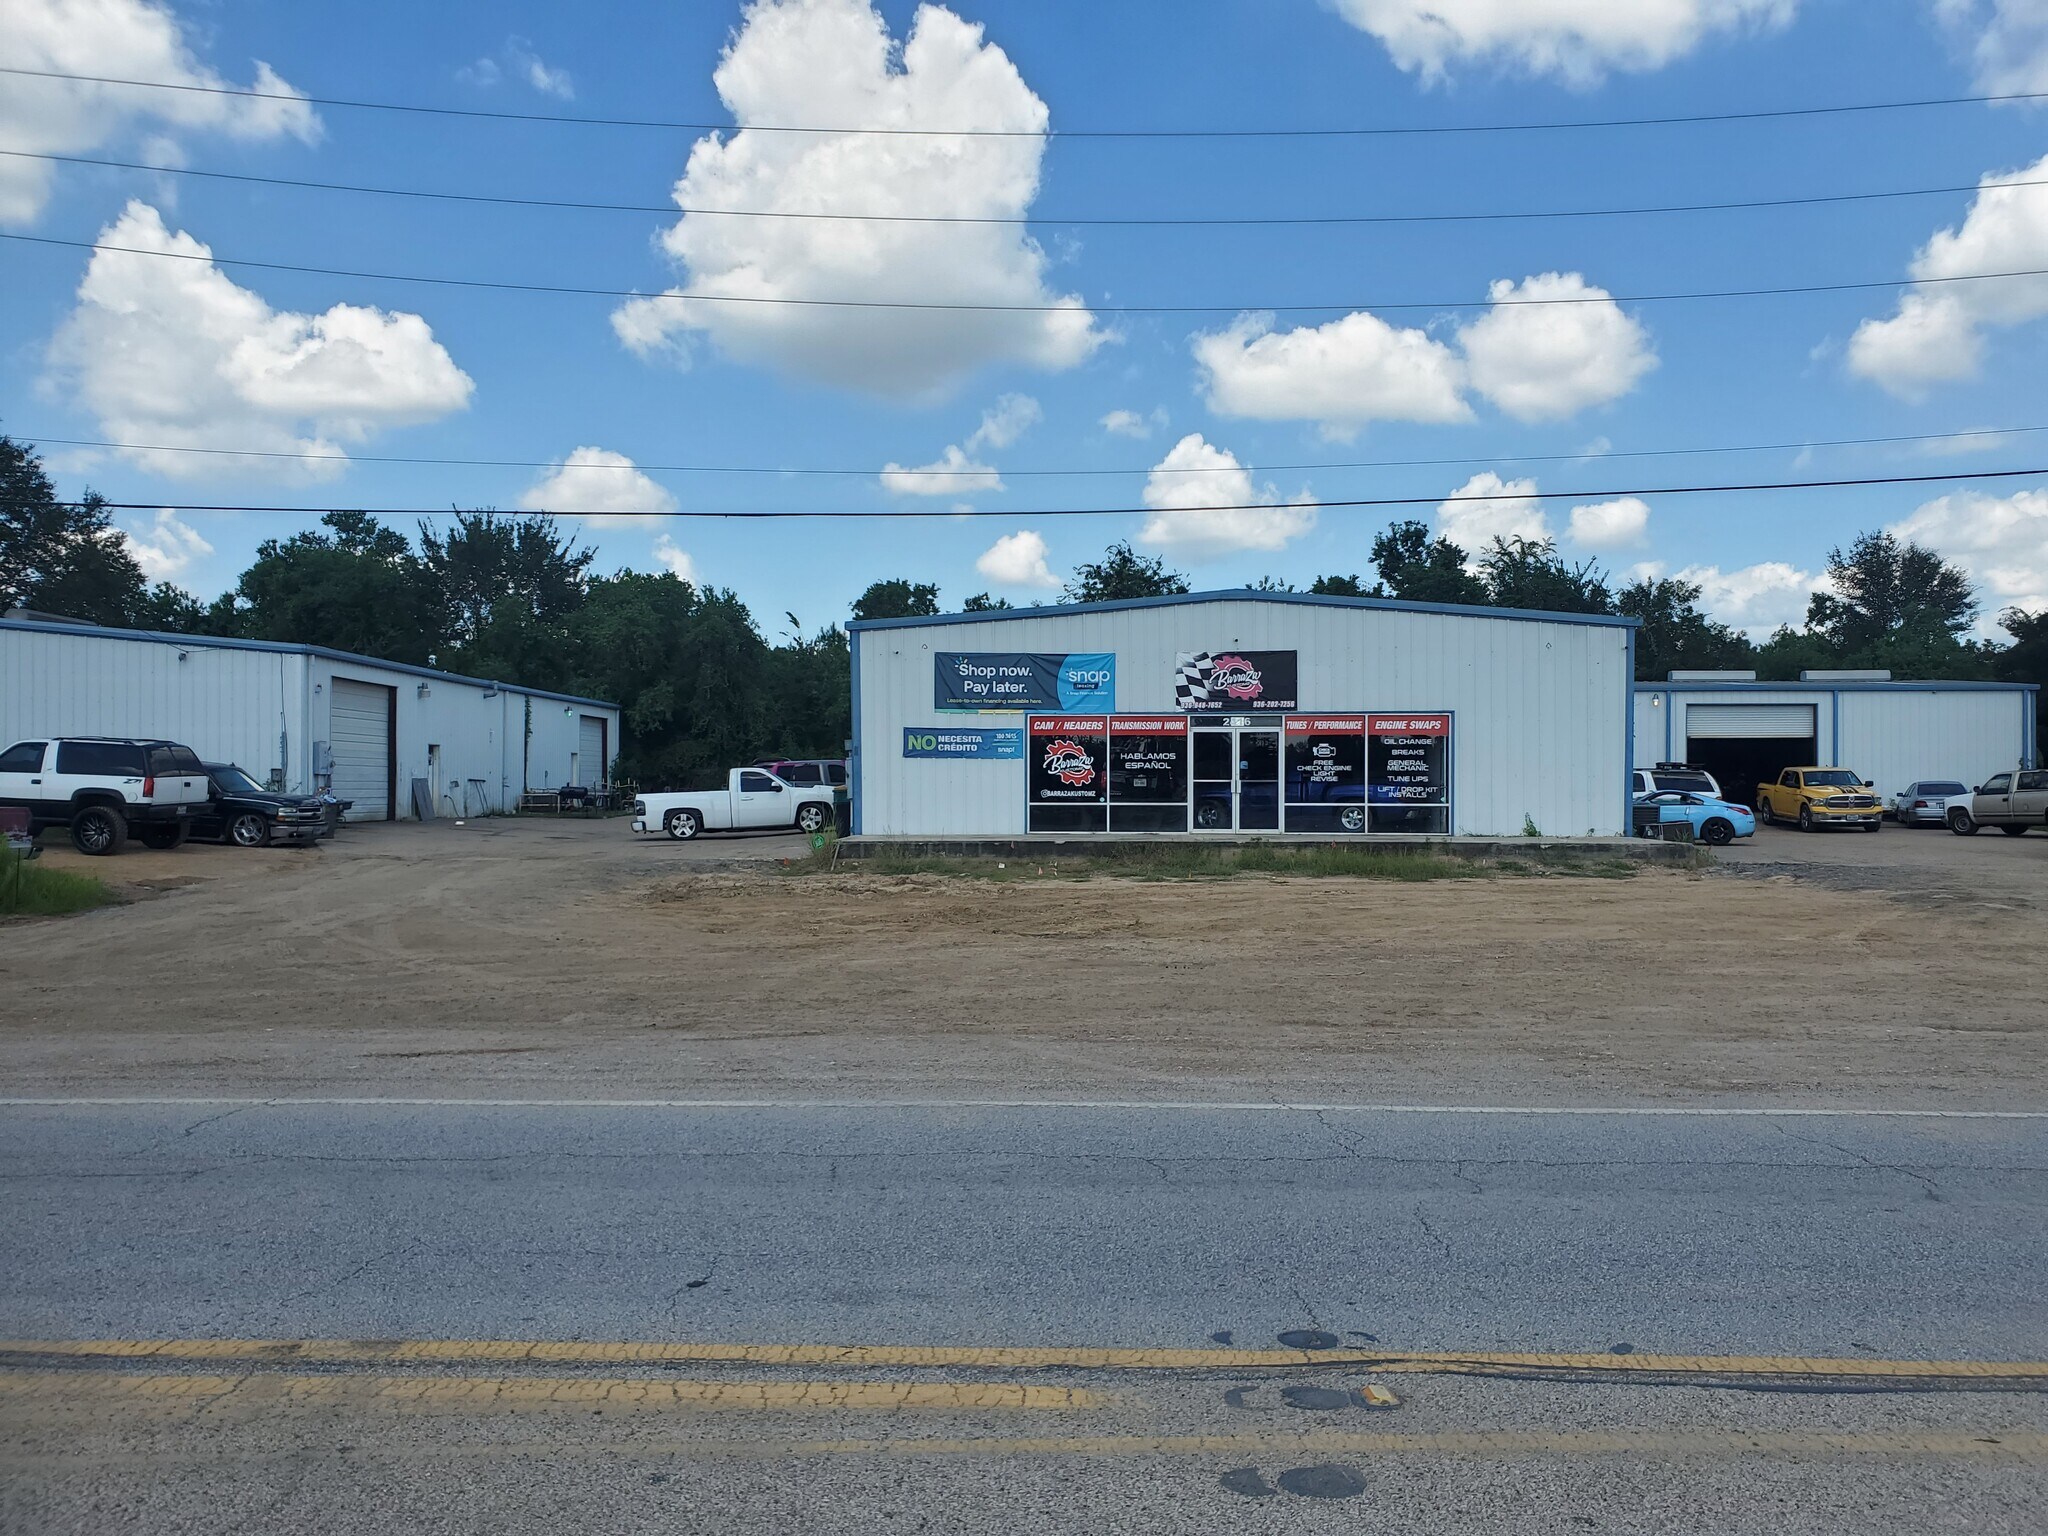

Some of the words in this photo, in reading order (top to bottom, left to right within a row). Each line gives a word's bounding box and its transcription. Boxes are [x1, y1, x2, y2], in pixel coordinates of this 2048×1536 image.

[959, 663, 996, 679] Shop
[999, 667, 1033, 677] now.
[1068, 670, 1110, 686] snap
[964, 681, 989, 696] Pay
[993, 681, 1028, 693] later.
[1034, 721, 1054, 730] CAM
[1056, 721, 1061, 730] /
[1063, 721, 1104, 730] HEADERS
[1111, 721, 1162, 730] TRANSMISSION
[1164, 721, 1185, 730] WORK
[1286, 721, 1307, 730] TUNES
[1308, 721, 1312, 730] /
[1313, 721, 1363, 730] PERFORMANCE
[1375, 721, 1407, 730] ENGINE
[1409, 721, 1441, 730] SWAPS
[908, 734, 937, 751] NO
[938, 735, 983, 743] NECESITA
[938, 743, 978, 752] CRÉDITO
[1120, 752, 1176, 760] HABLAMOS
[1125, 760, 1172, 769] ESPAÑOL
